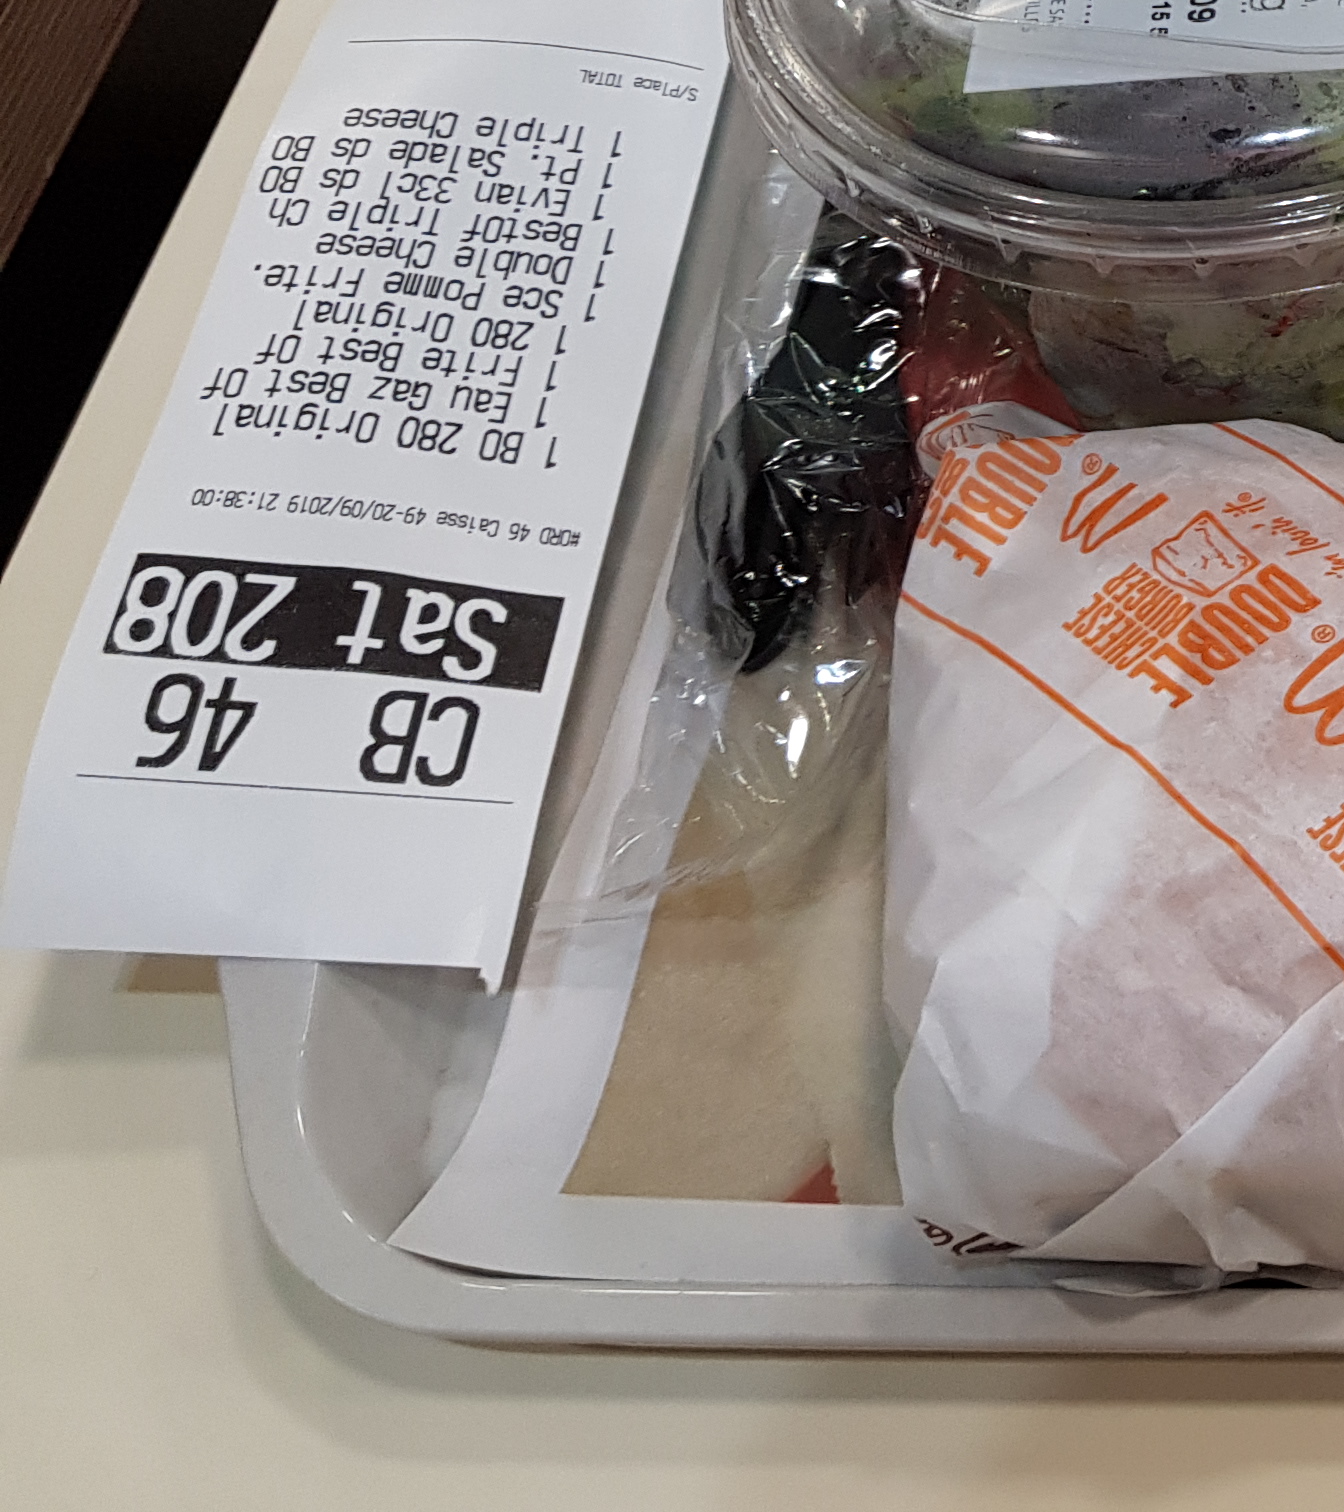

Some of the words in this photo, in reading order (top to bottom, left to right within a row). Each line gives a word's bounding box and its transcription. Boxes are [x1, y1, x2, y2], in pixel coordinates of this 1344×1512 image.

[1150, 1, 1172, 21] 15
[579, 68, 622, 88] TOTAL
[633, 76, 698, 101] S/Place
[343, 107, 459, 139] Cheese
[475, 115, 584, 154] Triple
[270, 134, 315, 162] BO
[330, 137, 372, 165] ds
[388, 139, 506, 178] Salade
[609, 130, 621, 158] 1
[258, 164, 304, 194] BO
[318, 167, 360, 197] ds
[530, 153, 582, 185] Pt.
[600, 161, 612, 189] 1
[378, 170, 458, 204] 33cl
[473, 180, 571, 217] Evian
[268, 197, 310, 227] Ch
[326, 193, 440, 236] Triple
[591, 193, 604, 221] 1
[459, 213, 583, 252] BestOf
[601, 227, 614, 256] 1
[315, 232, 436, 269] Cheese
[453, 245, 574, 285] Double
[253, 263, 365, 297] Frite.
[382, 270, 486, 311] Pomme
[592, 259, 605, 289] 1
[502, 284, 564, 319] Sce
[583, 292, 595, 322] 1
[291, 299, 454, 343] Original
[470, 316, 535, 351] 280
[252, 333, 302, 365] Of
[316, 335, 404, 373] Best
[553, 324, 567, 355] 1
[199, 366, 249, 400] Of
[420, 346, 523, 387] Frite
[543, 360, 557, 392] 1
[263, 368, 352, 404] Best
[366, 375, 433, 411] Gaz
[449, 384, 512, 424] Eau
[534, 396, 547, 429] 1
[211, 401, 380, 443] Original
[396, 415, 463, 455] 280
[478, 428, 524, 464] BO
[544, 435, 557, 469] 1
[929, 432, 1085, 578] OUBLE
[113, 566, 298, 663] 208
[1101, 561, 1198, 638] BURGER
[337, 581, 508, 681] Sat
[1061, 591, 1160, 671] CHEESE
[1127, 562, 1322, 709] DOUBLE
[134, 672, 258, 772] 46
[358, 689, 480, 787] CB
